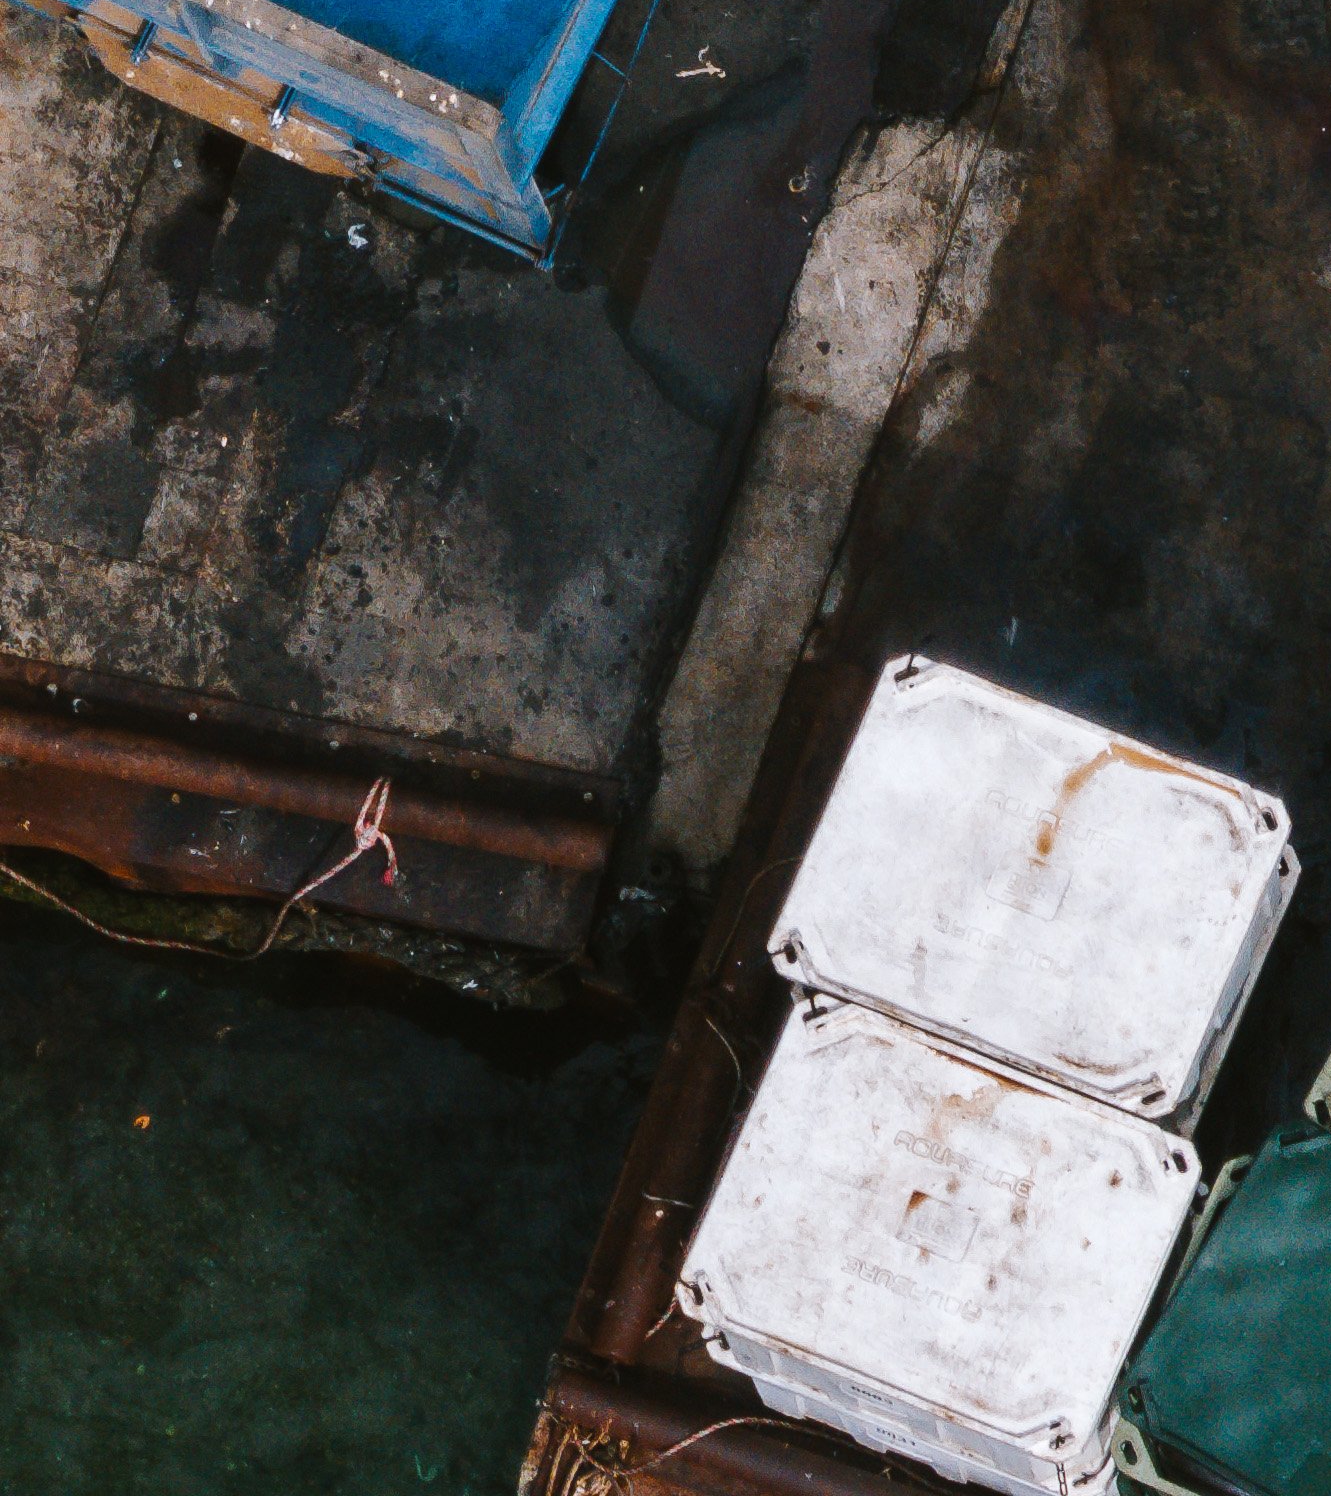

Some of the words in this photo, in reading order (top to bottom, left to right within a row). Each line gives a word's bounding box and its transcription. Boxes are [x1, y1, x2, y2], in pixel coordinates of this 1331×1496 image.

[984, 788, 1123, 857] AQUASURE
[894, 1130, 1035, 1199] AQUASURE
[840, 1256, 982, 1323] AQUASURE
